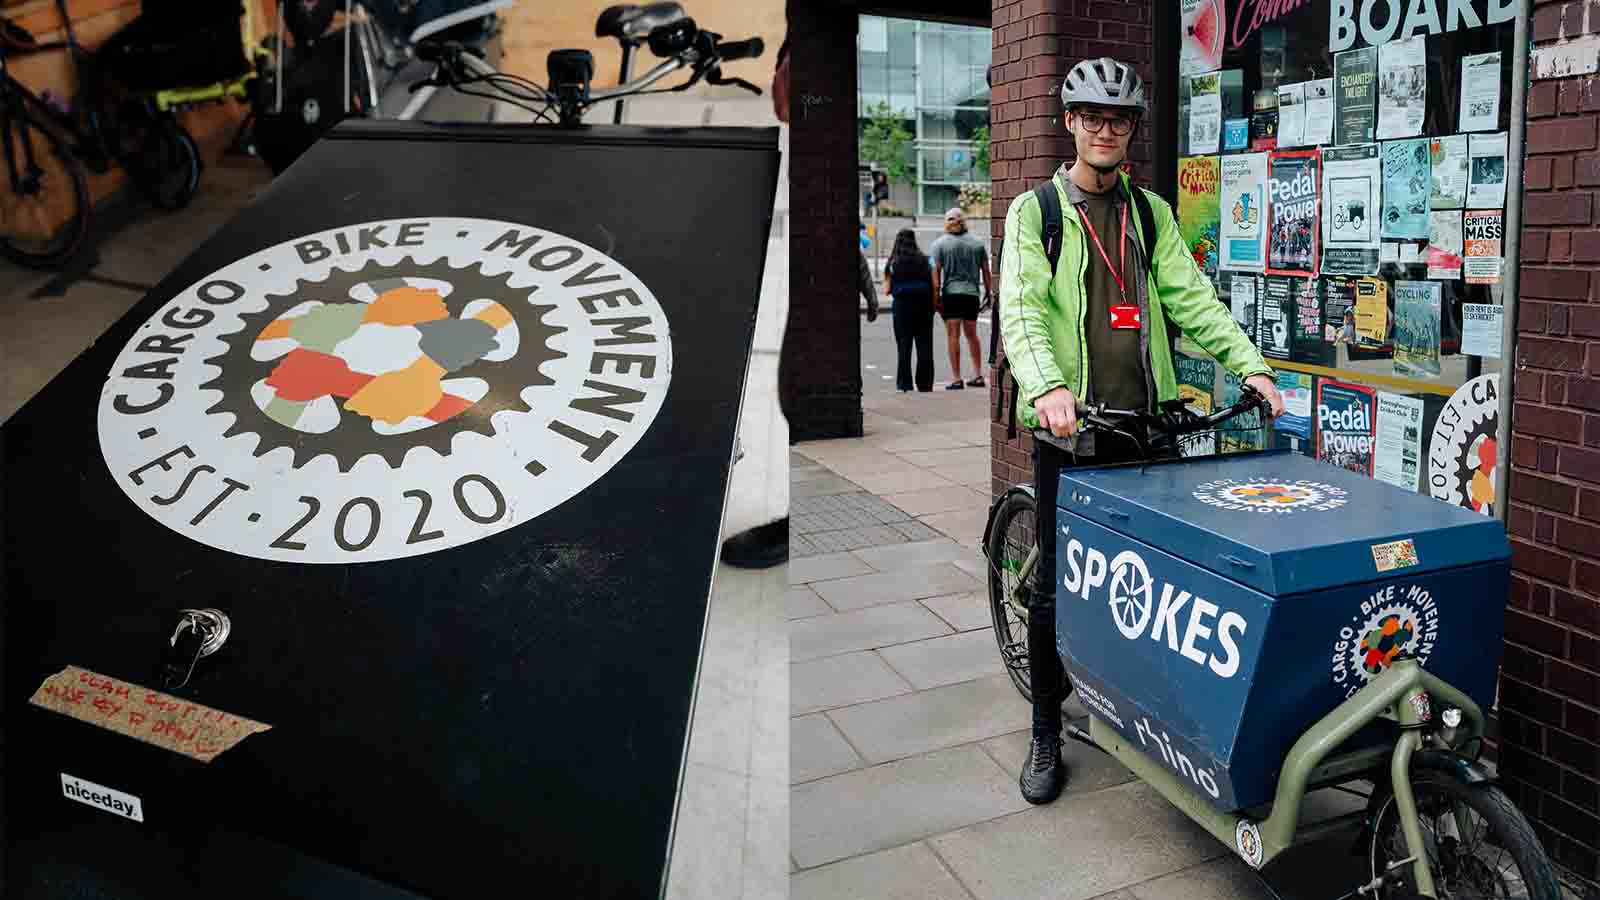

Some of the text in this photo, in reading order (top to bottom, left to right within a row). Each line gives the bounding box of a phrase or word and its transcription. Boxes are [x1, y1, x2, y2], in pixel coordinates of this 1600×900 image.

[1268, 167, 1316, 203] Pedal
[1274, 198, 1320, 225] Power
[1465, 216, 1501, 227] CRITICAL
[1465, 225, 1501, 240] MASS
[1396, 288, 1431, 300] CYCLING
[112, 221, 657, 464] CARGO BIKE MOVEMENT
[1317, 403, 1370, 430] Pedal
[1323, 430, 1375, 455] Power
[128, 444, 507, 553] EST 2020
[1063, 538, 1248, 678] SPOKES
[1332, 584, 1439, 683] CARGO BIKE MOVEMENT
[1133, 717, 1220, 799] rhino
